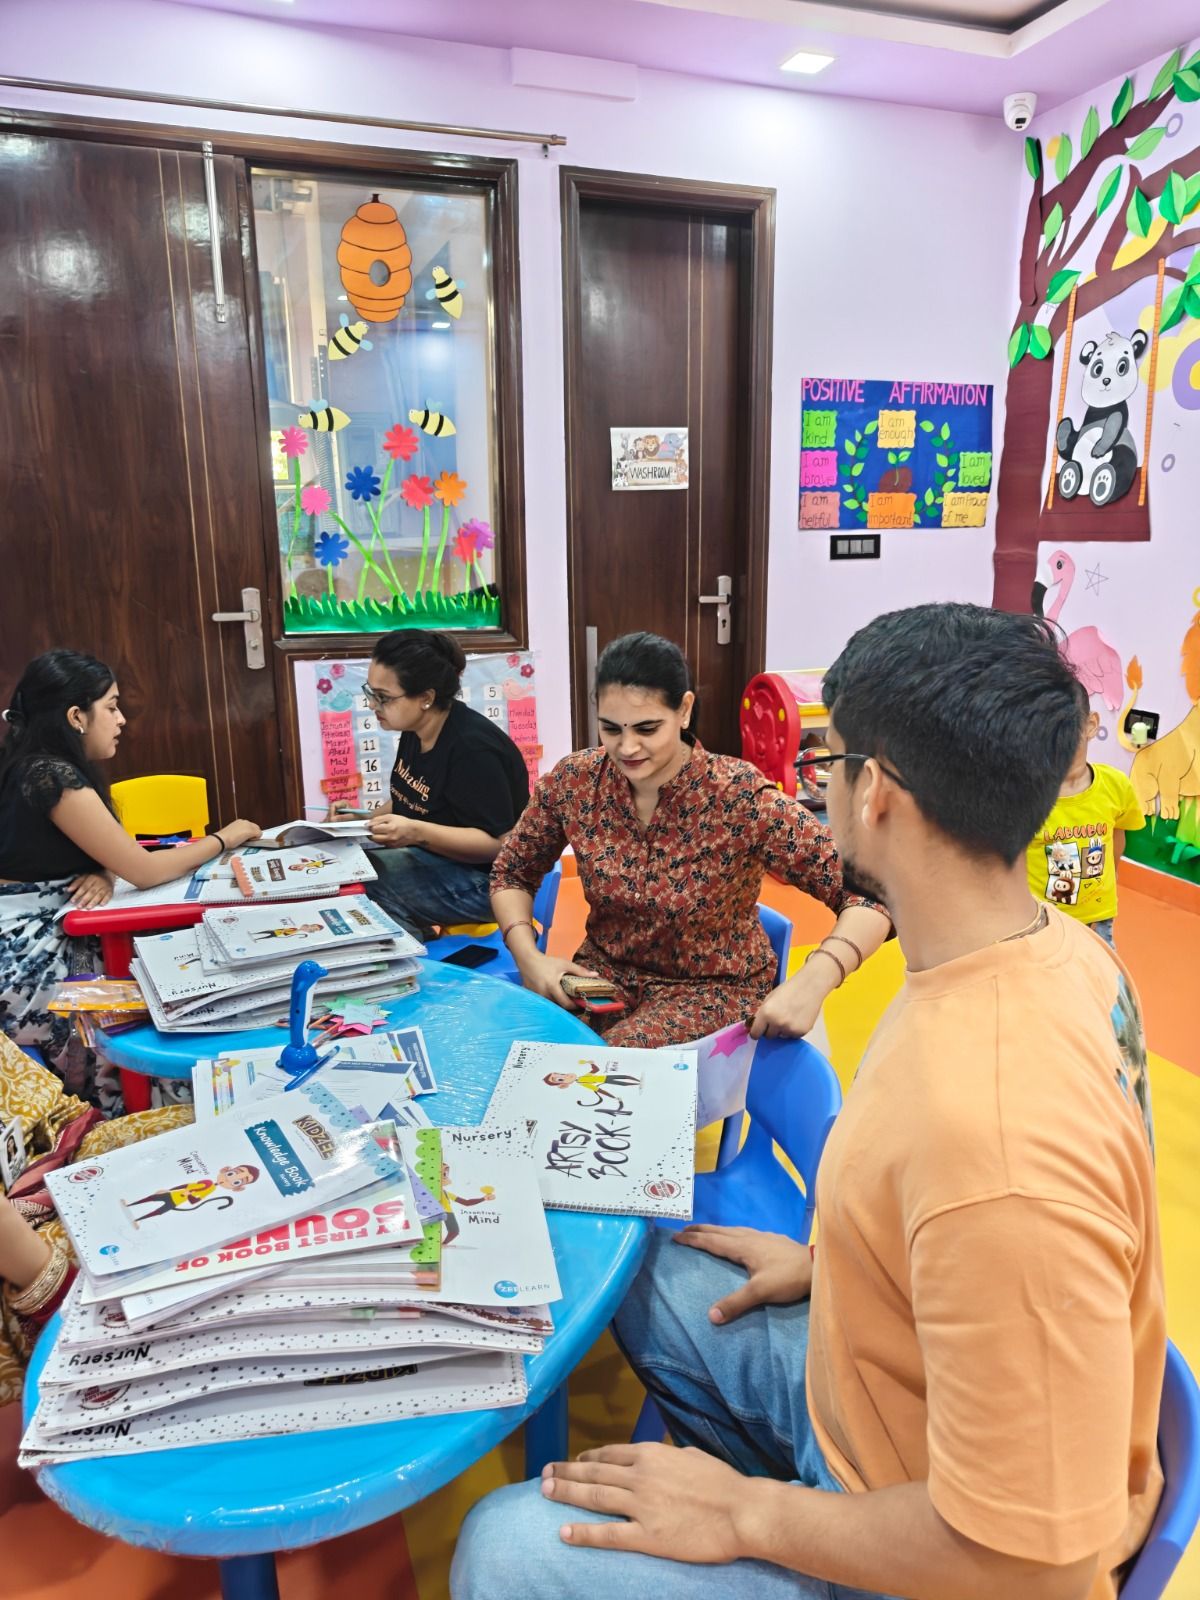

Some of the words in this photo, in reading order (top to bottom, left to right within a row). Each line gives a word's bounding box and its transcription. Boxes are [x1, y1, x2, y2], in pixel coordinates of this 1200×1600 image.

[801, 378, 865, 402] POSITIVE
[889, 381, 988, 406] AFFIRMATION
[805, 412, 811, 427] I
[815, 415, 831, 426] am
[888, 417, 905, 427] am
[805, 430, 828, 445] kind
[879, 429, 914, 447] enough
[812, 456, 830, 467] am
[969, 456, 986, 468] am
[629, 466, 672, 480] WASHROOM
[811, 494, 829, 506] am
[877, 495, 893, 506] am
[955, 513, 969, 524] me
[489, 686, 497, 698] 5
[487, 707, 500, 718] 10
[363, 718, 371, 730] 6
[363, 739, 376, 751] 11
[364, 759, 378, 773] 16
[366, 781, 382, 792] 21
[1043, 823, 1108, 843] LABUBU
[170, 982, 217, 996] Nursery
[292, 1115, 336, 1160] KIDZEE
[452, 1129, 513, 1143] Nursery
[254, 1126, 290, 1166] Knowledge
[285, 1166, 307, 1188] Book
[177, 1157, 199, 1175] Mind
[468, 1215, 500, 1224] Mind
[298, 1228, 369, 1248] FIRST
[217, 1243, 290, 1264] BOOK
[175, 1256, 210, 1272] OF
[69, 1344, 151, 1367] Nursery
[61, 1422, 132, 1438] Nurse
